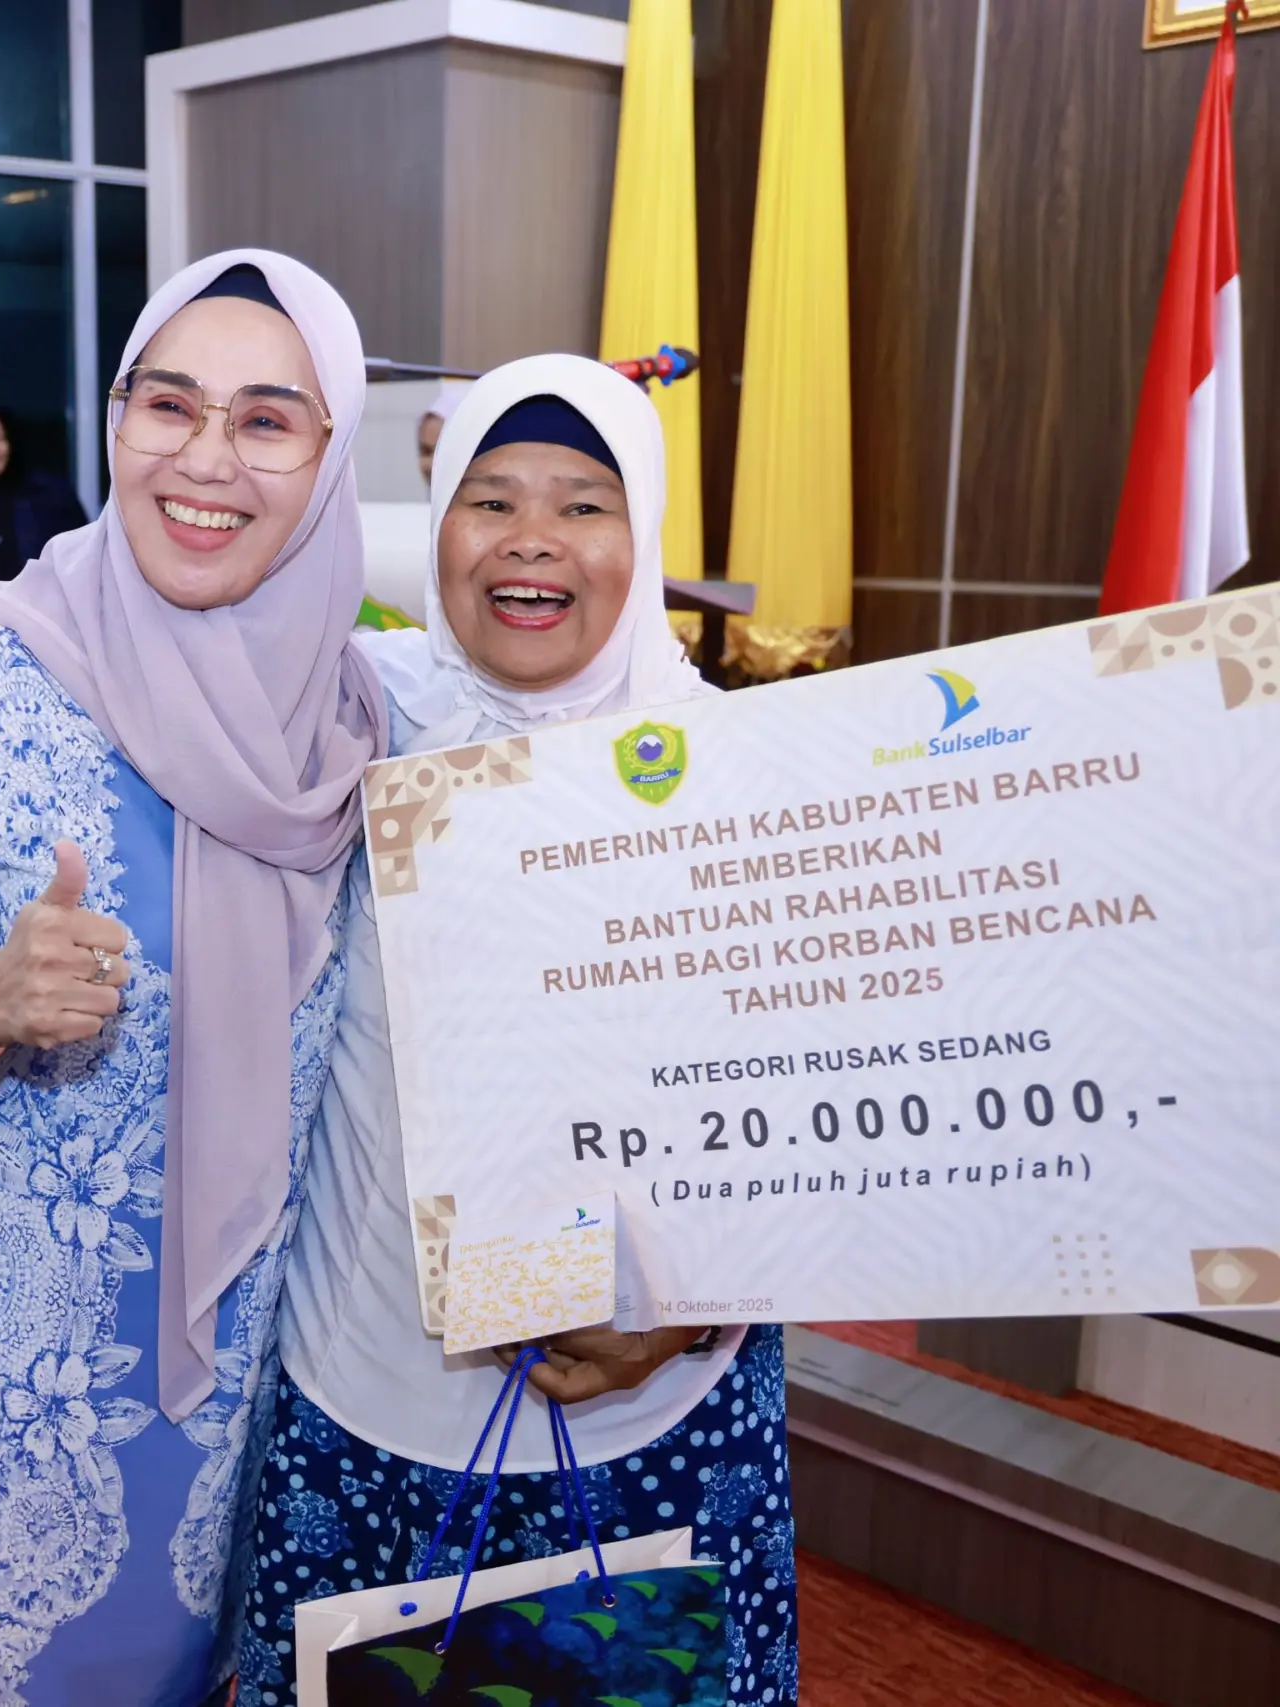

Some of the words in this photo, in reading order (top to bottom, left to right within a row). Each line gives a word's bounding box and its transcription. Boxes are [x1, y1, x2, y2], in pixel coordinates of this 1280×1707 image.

[639, 772, 669, 782] BARRU
[520, 817, 737, 874] PEMERINTAH
[750, 778, 980, 838] KABUPATEN
[993, 752, 1140, 800] BARRU
[690, 829, 942, 890] MEMBERIKAN
[605, 898, 773, 944] BANTUAN
[785, 858, 1060, 920] RAHABILITASI
[543, 956, 664, 994] RUMAH
[675, 943, 762, 978] BAGI
[773, 921, 936, 967] KORBAN
[949, 894, 1157, 945] BENCANA
[723, 977, 847, 1015] TAHUN
[859, 967, 944, 1000] 2025
[652, 1054, 795, 1087] KATEGORI
[805, 1043, 909, 1073] RUSAK
[918, 1029, 1052, 1063] SEDANG
[572, 1121, 673, 1167] Rp.
[700, 1079, 1177, 1151] 20.000.000,-
[651, 1180, 733, 1207] (Dua
[747, 1169, 846, 1201] puluh
[857, 1166, 931, 1196] juta
[947, 1153, 1091, 1187] rupiah)
[677, 1299, 733, 1314] Oktober
[737, 1298, 774, 1313] 2025
